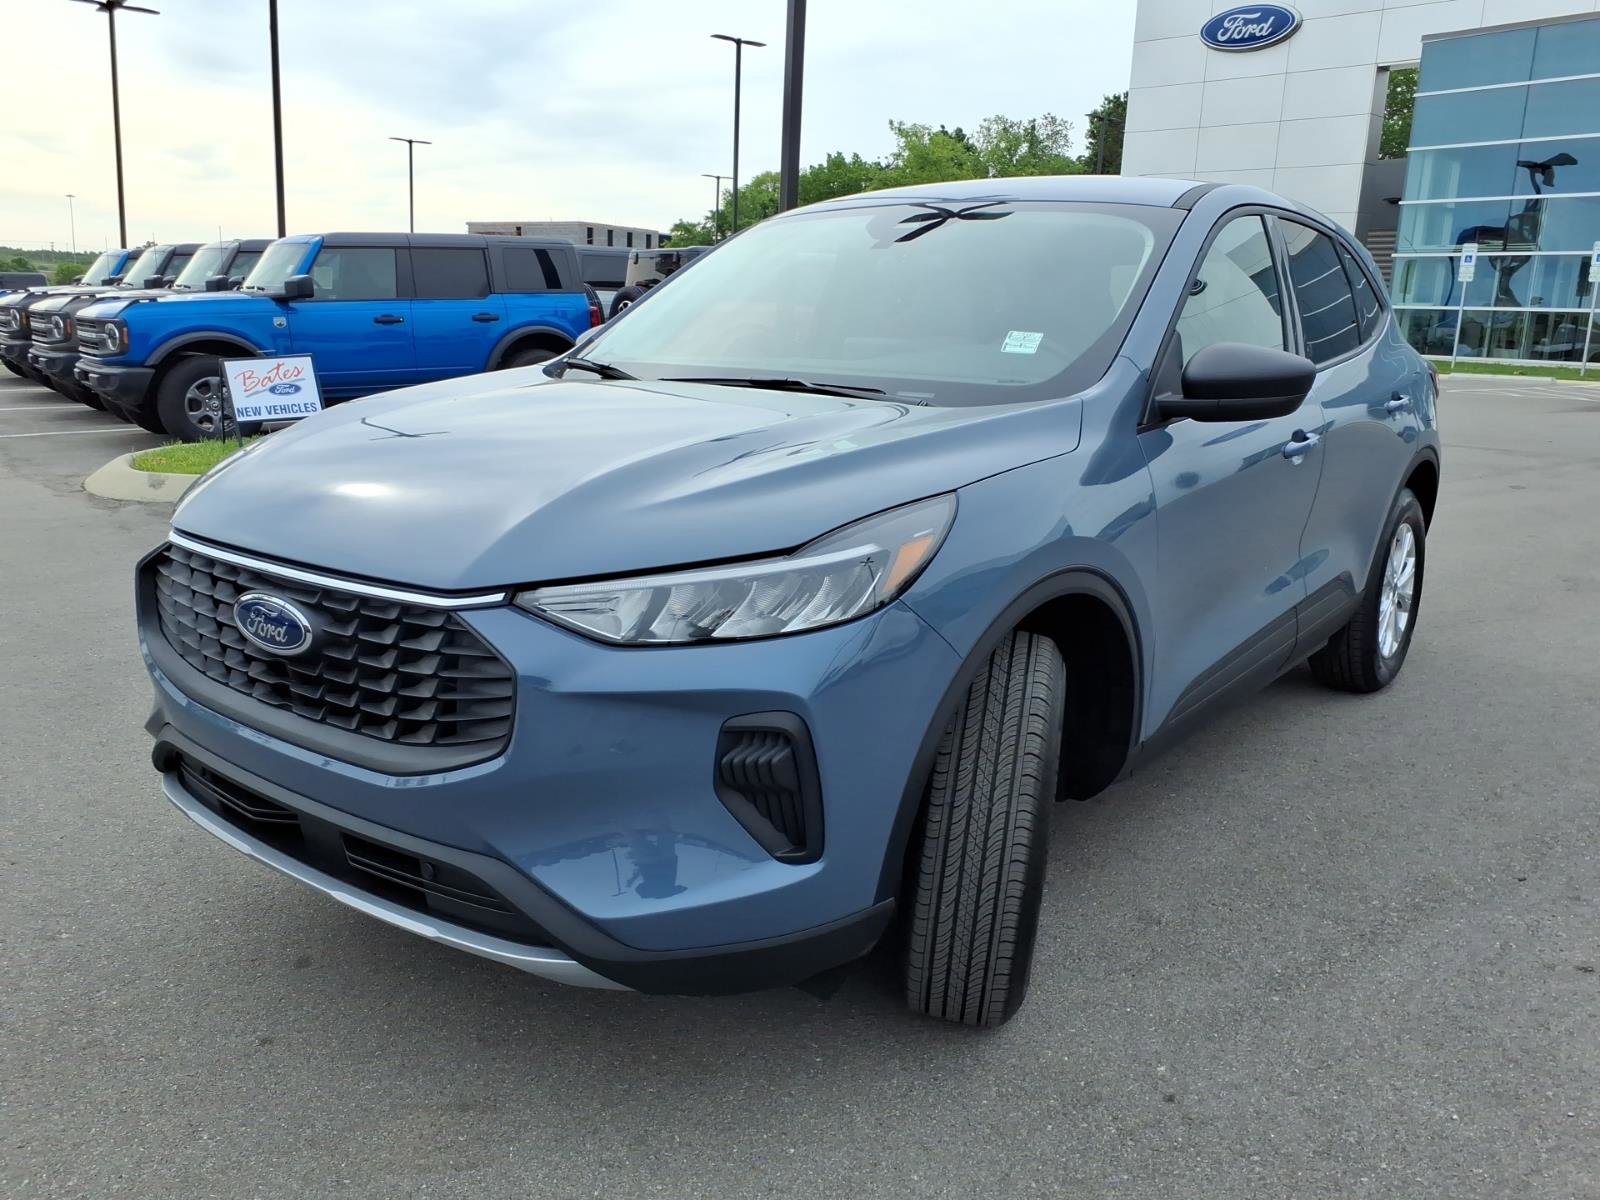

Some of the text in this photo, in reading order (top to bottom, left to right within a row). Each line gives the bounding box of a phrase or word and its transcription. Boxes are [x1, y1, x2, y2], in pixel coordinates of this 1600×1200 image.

[1217, 12, 1276, 42] Ford
[234, 361, 304, 393] Bates
[274, 384, 296, 394] Ford
[236, 402, 318, 418] NEW VEHICLES
[246, 605, 288, 643] Ford
